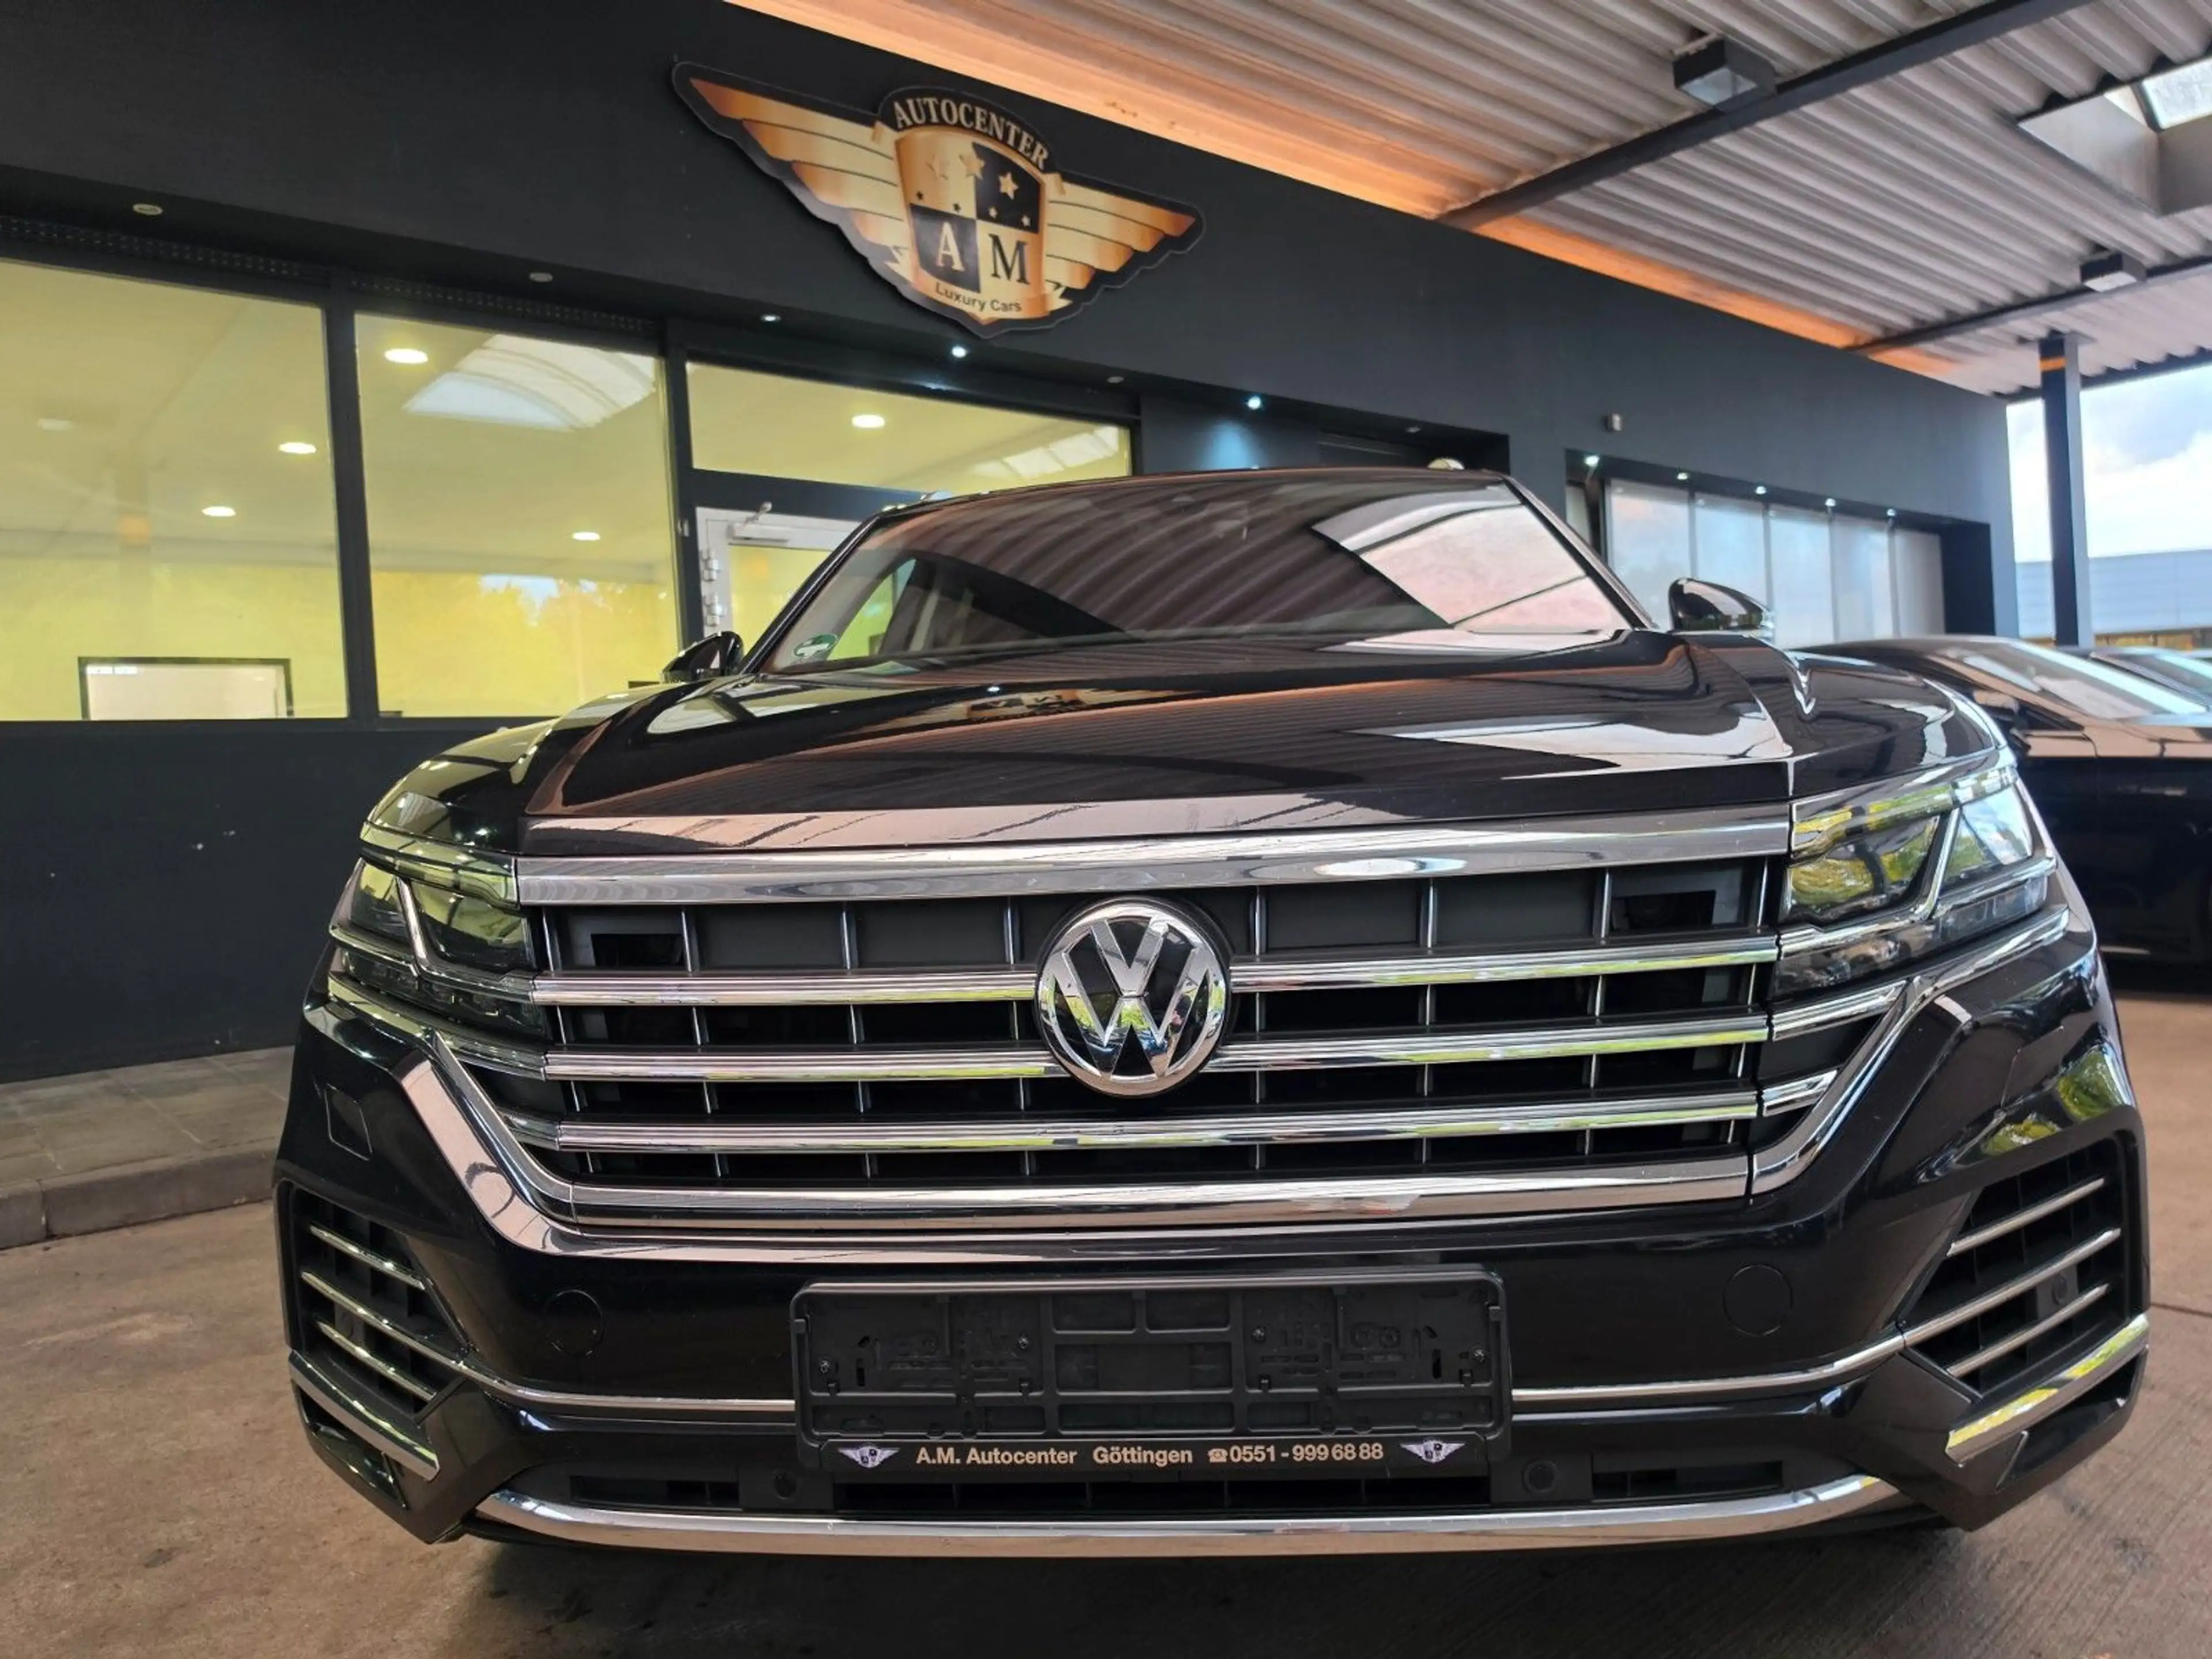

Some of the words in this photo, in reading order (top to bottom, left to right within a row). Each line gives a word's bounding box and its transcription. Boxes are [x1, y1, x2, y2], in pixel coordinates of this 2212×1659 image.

[893, 97, 1049, 170] AUTOCENTER
[935, 282, 987, 312] Luxury
[990, 299, 1022, 312] Cars
[1048, 913, 1213, 1082] VW
[916, 1447, 960, 1464] A.M.
[966, 1447, 1077, 1464] Autocenter
[1093, 1446, 1192, 1467] Göttingen
